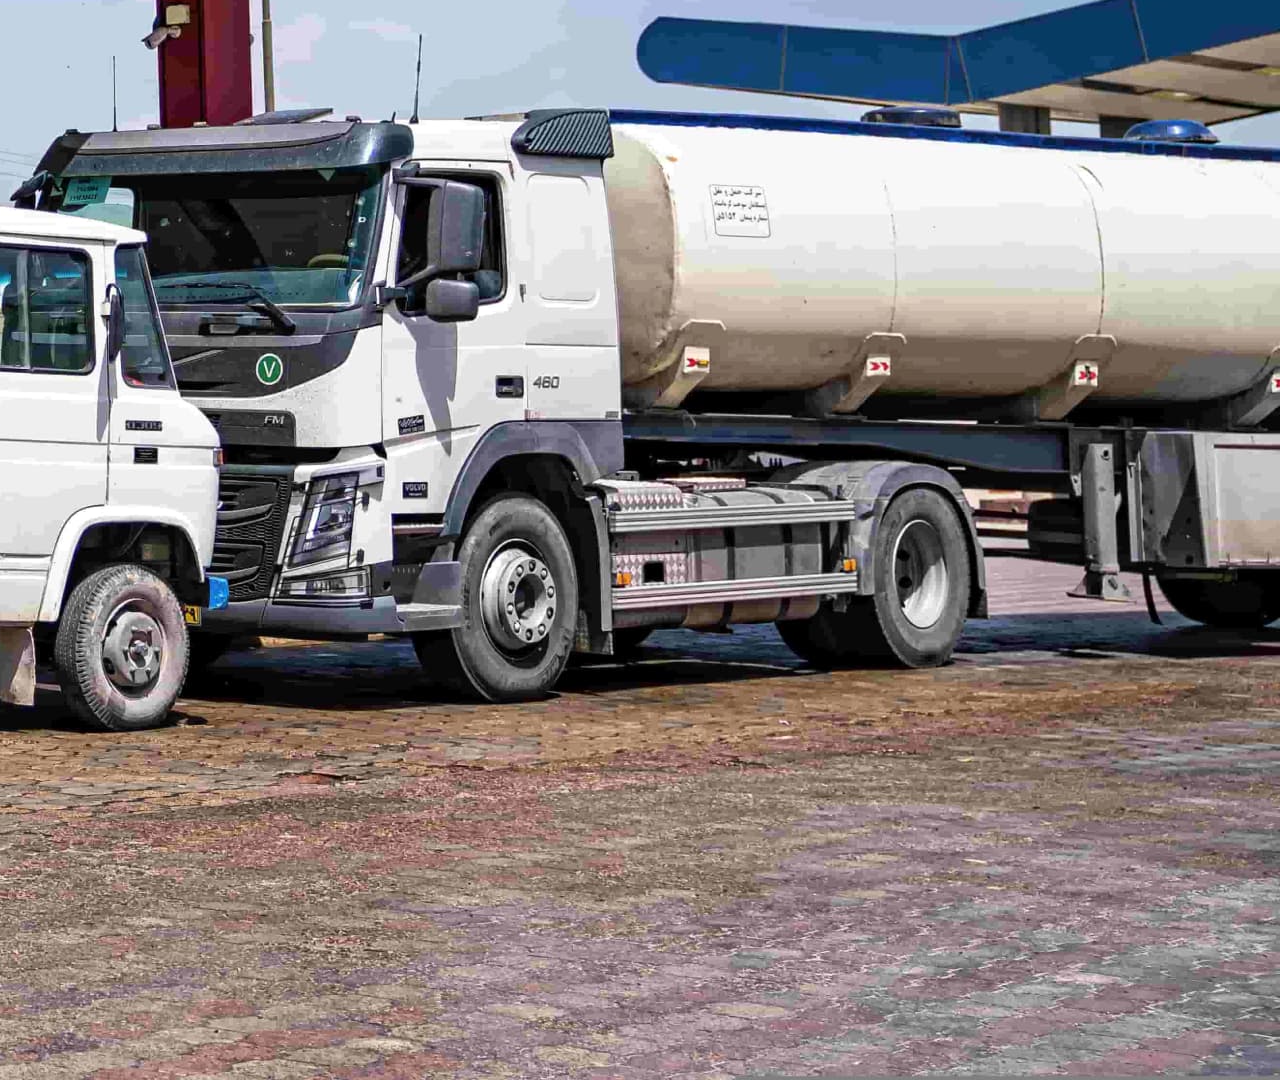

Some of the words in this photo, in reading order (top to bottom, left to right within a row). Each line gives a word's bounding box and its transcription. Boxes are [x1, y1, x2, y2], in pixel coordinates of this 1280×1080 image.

[263, 360, 276, 378] V
[533, 376, 560, 389] 460
[264, 415, 285, 425] FM
